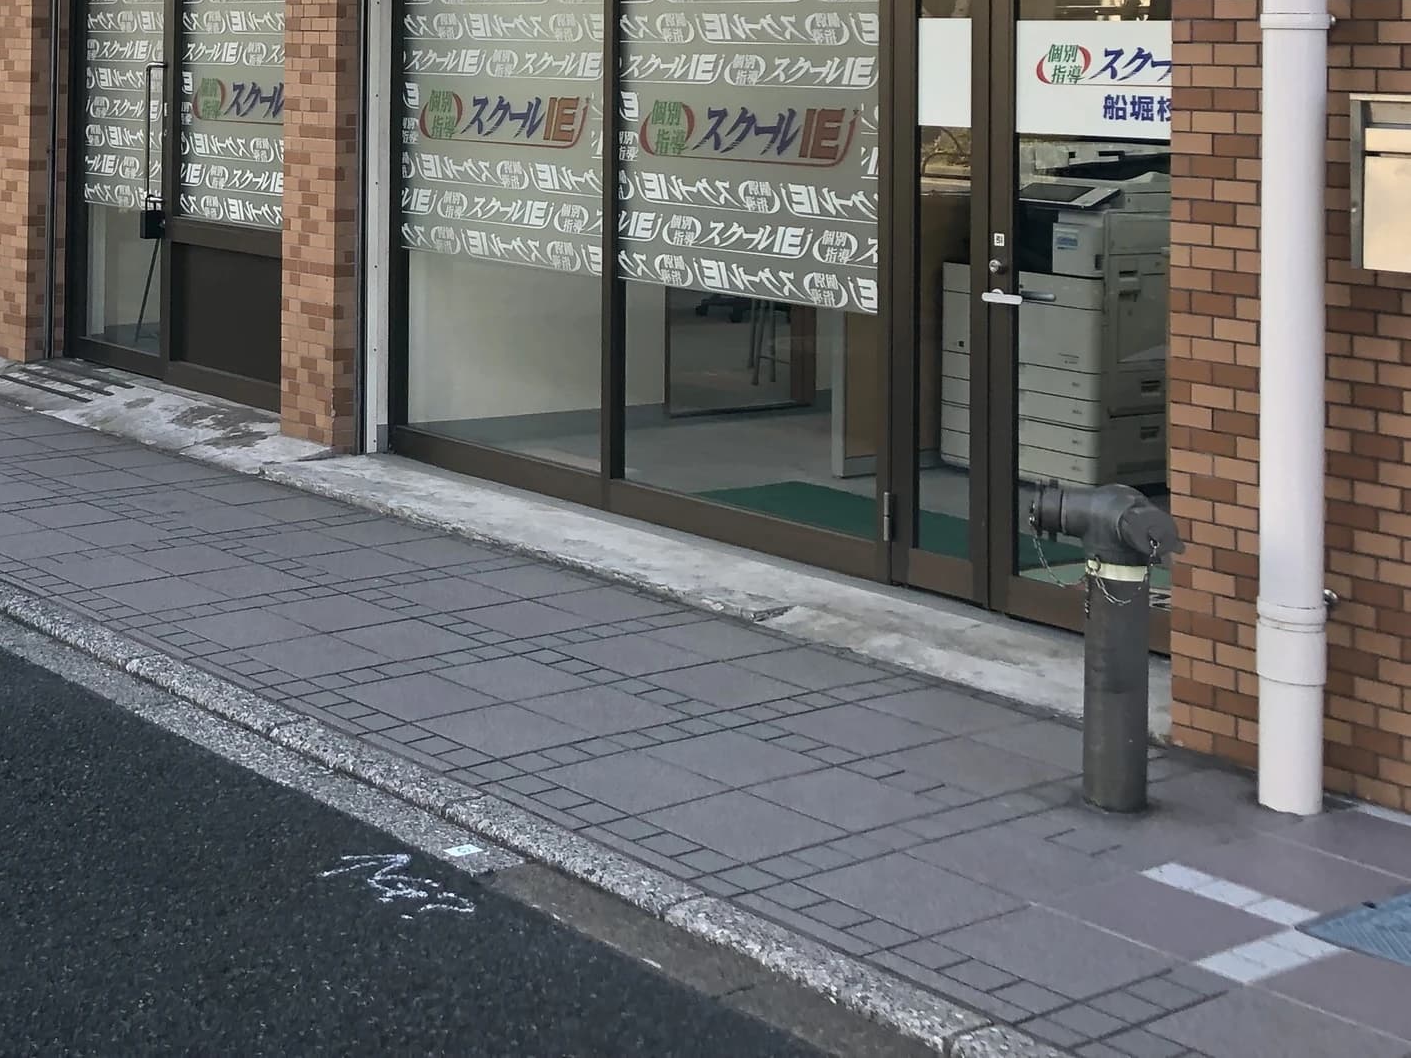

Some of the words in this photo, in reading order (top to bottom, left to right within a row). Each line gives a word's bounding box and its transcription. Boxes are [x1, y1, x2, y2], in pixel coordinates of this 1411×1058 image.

[622, 53, 718, 80] スクールIE
[1048, 44, 1079, 63] 個別
[763, 57, 876, 85] スクールIE
[1051, 64, 1085, 84] 指導
[461, 95, 580, 142] スクールIE
[692, 107, 847, 160] スクールIE
[700, 222, 805, 255] スクールIE
